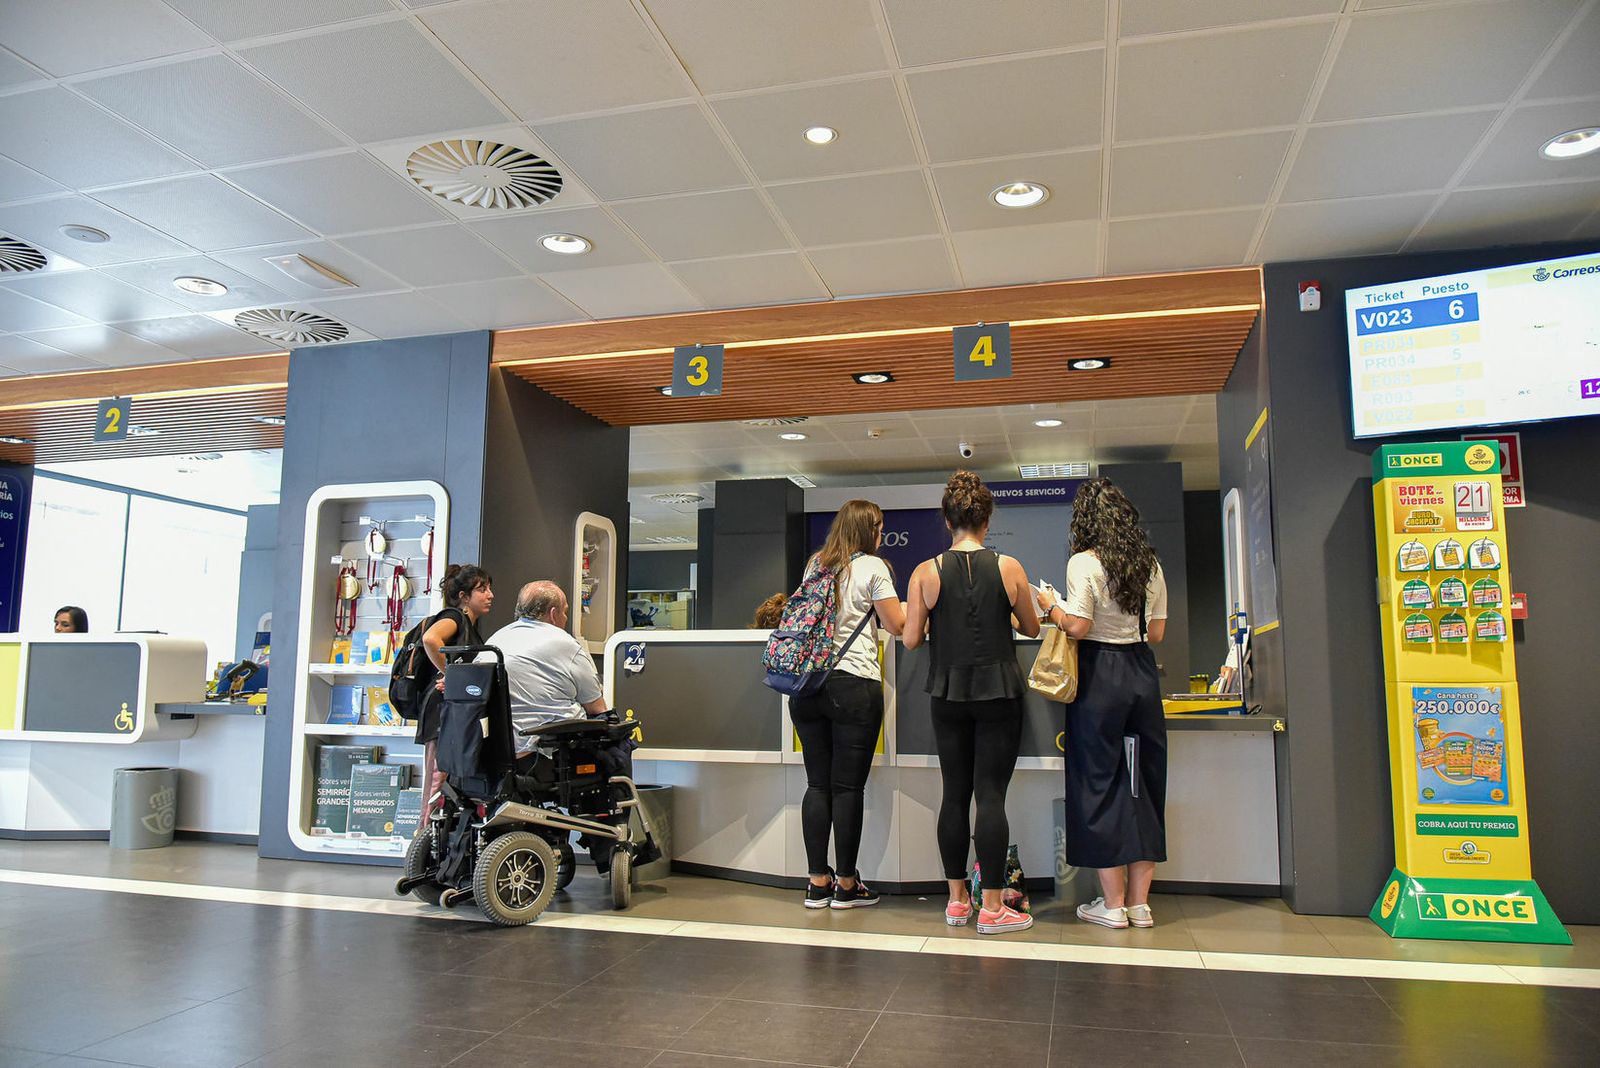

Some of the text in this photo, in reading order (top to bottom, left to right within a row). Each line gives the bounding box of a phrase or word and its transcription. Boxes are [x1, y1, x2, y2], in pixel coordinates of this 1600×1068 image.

[1364, 281, 1470, 304] Ticket Puesto
[1360, 299, 1465, 329] V023 6
[968, 335, 997, 367] 4
[685, 355, 710, 387] 3
[104, 407, 121, 433] 2
[1403, 455, 1439, 465] ONCE
[990, 487, 1066, 497] NUEVOS SERVICIOS
[1399, 485, 1435, 496] BOTE
[1400, 496, 1445, 506] viernes
[1458, 485, 1484, 507] 21
[1406, 517, 1441, 526] JACKPOT
[1417, 700, 1500, 715] 250.000€
[317, 777, 339, 785] Sobres
[316, 797, 350, 806] GRANDES
[352, 798, 395, 806] SEMIRRÍGIDOS
[352, 806, 384, 814] MEDIANOS
[1417, 820, 1446, 828] COBRA
[1483, 822, 1515, 830] PREMIO
[1451, 898, 1529, 918] ONCE
